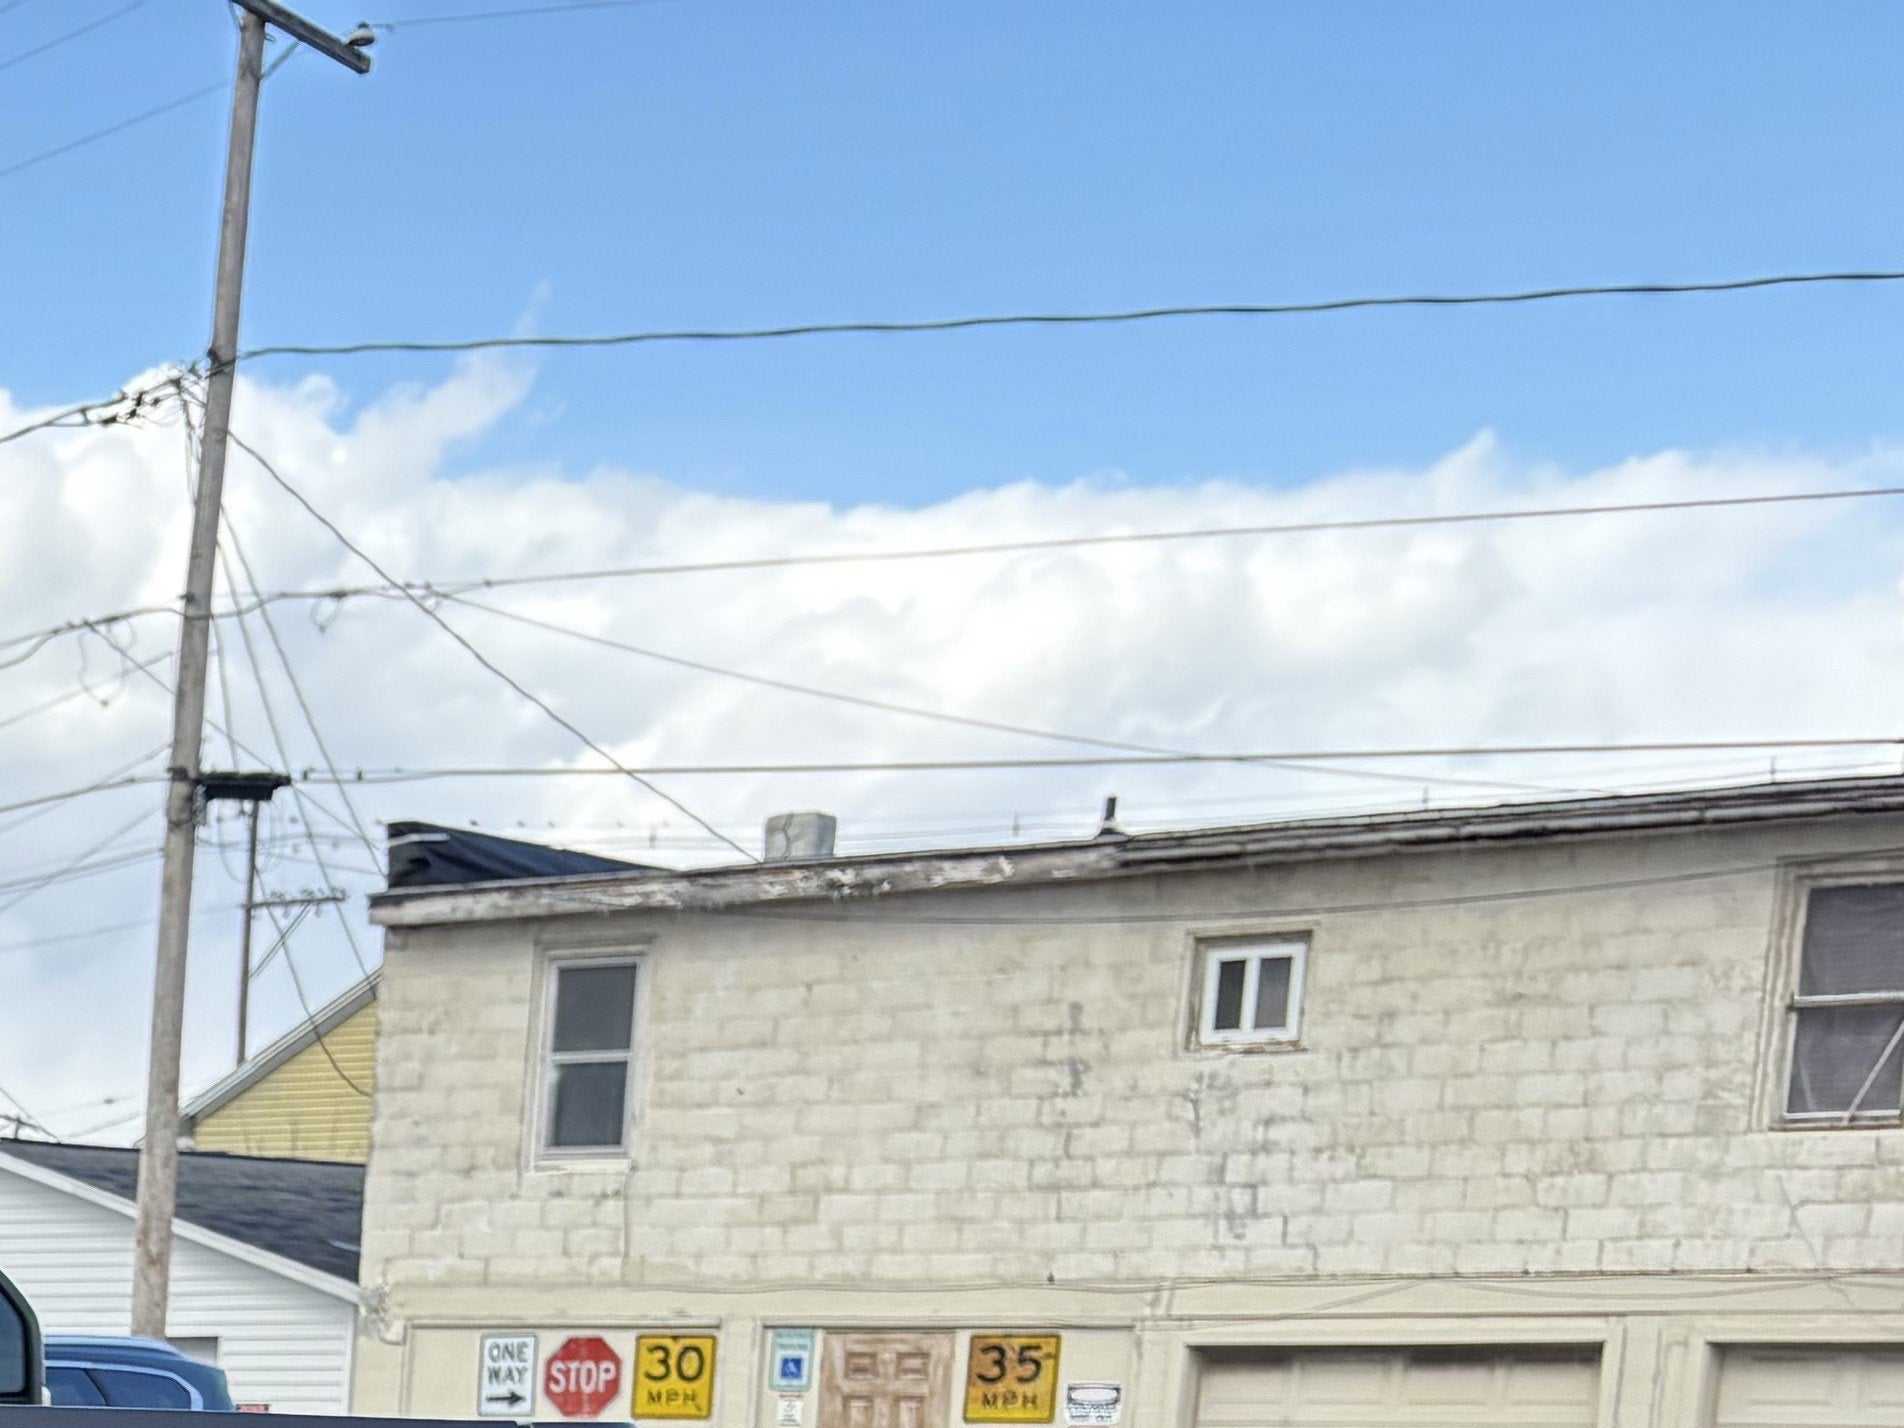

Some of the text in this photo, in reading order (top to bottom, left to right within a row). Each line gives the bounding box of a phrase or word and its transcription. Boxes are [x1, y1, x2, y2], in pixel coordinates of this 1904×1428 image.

[488, 1341, 528, 1363] ONE
[644, 1344, 705, 1382] 30
[487, 1365, 528, 1385] WAY
[976, 1344, 1042, 1385] 35
[548, 1360, 617, 1394] STOP
[647, 1388, 699, 1406] MPH
[982, 1389, 1038, 1409] MPH
